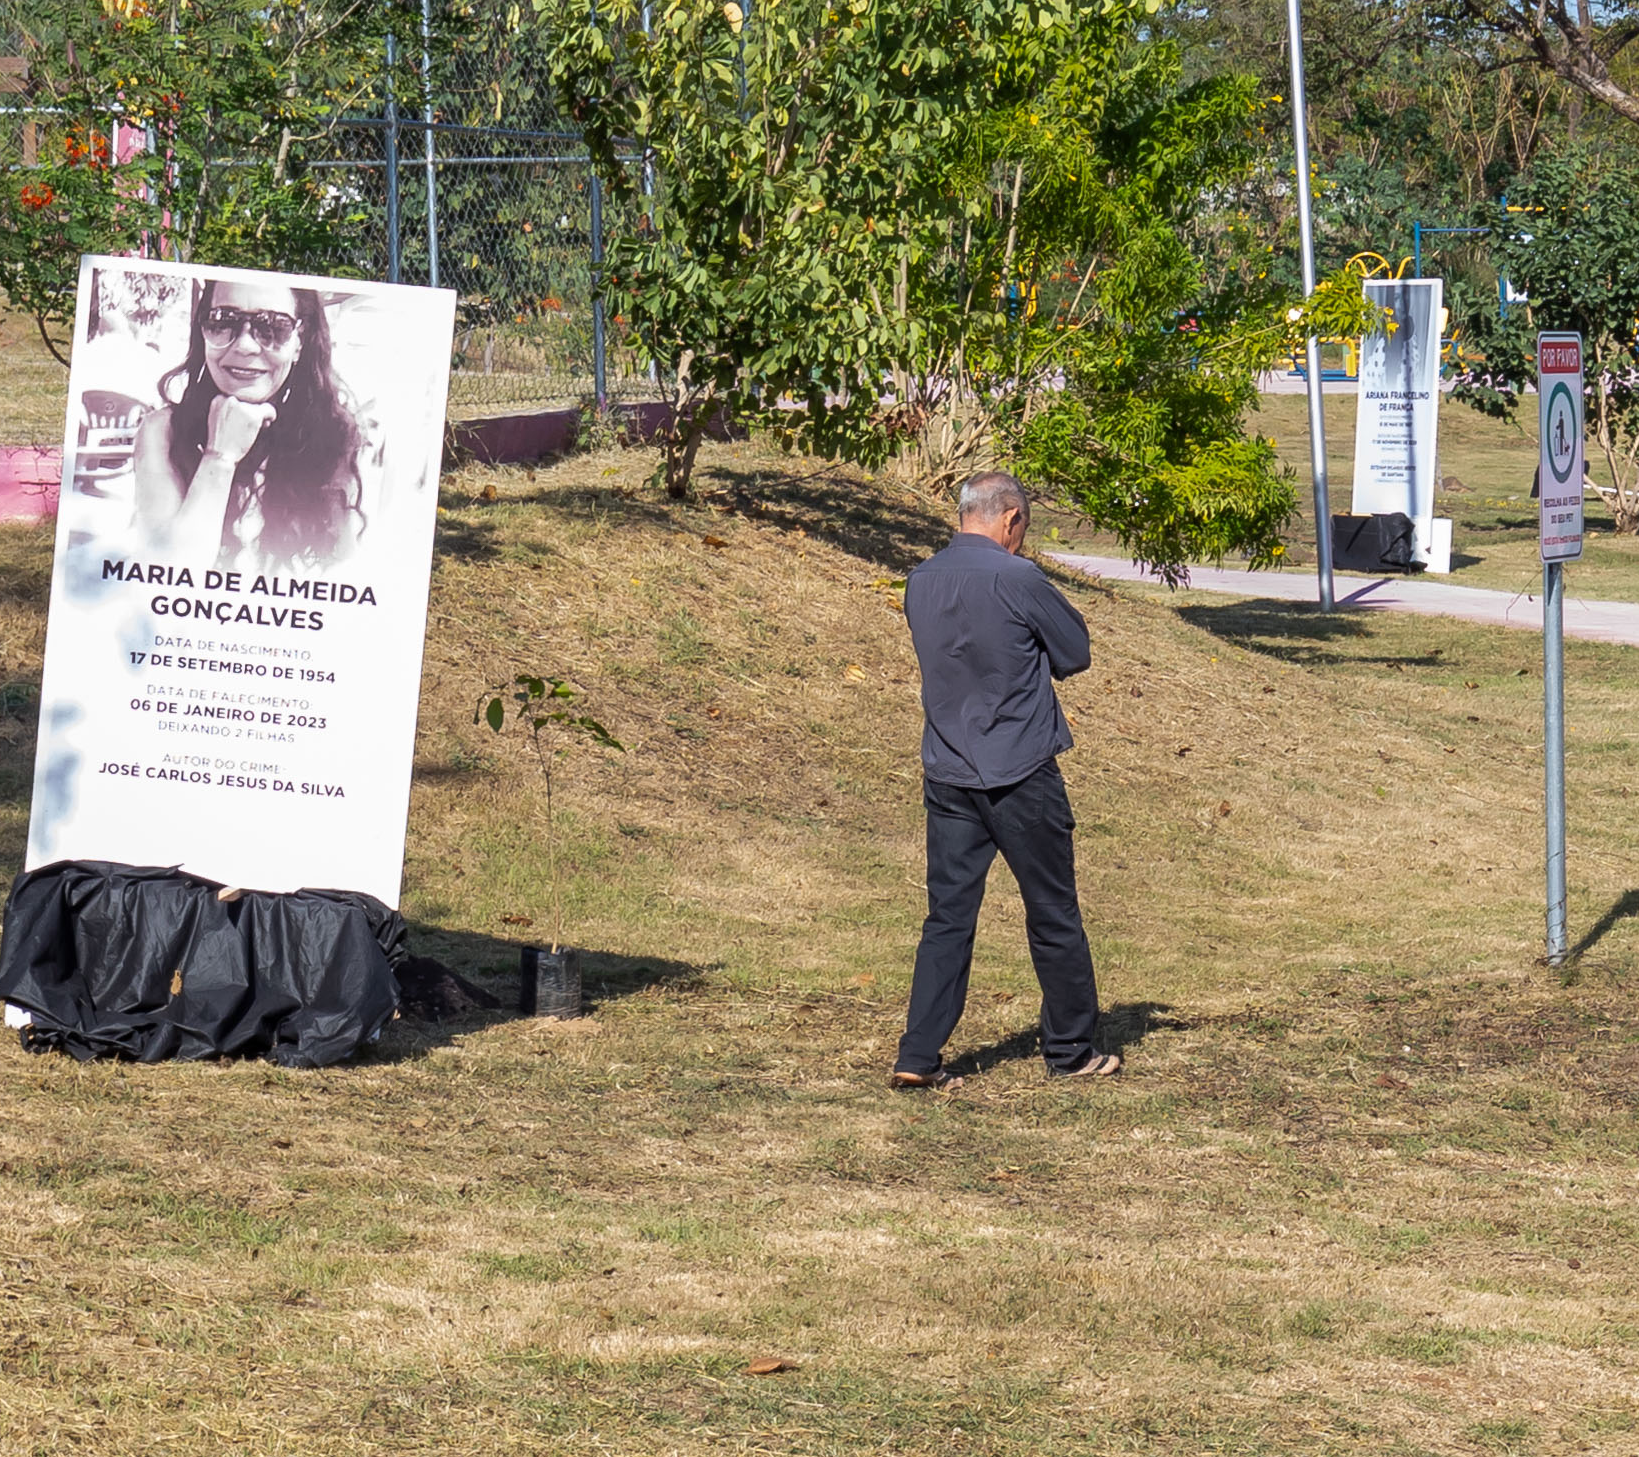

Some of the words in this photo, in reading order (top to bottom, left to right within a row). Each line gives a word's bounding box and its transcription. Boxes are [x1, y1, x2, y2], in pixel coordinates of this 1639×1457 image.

[1543, 348, 1555, 367] POR
[1557, 348, 1578, 367] FAVOR
[1365, 391, 1389, 399] ARIANA
[1379, 403, 1386, 411] DE
[102, 559, 194, 588] MARIA
[204, 570, 242, 592] DE
[250, 575, 377, 606] ALMEIDA
[151, 595, 324, 631] GONÇALVES
[155, 635, 193, 648] DATA
[198, 640, 215, 652] DE
[130, 651, 146, 665] 17
[151, 654, 172, 667] DE
[178, 657, 267, 677] SETEMBRO
[273, 666, 294, 679] DE
[299, 669, 336, 683] 1954
[147, 684, 185, 697] DATA
[189, 689, 206, 700] DE
[130, 699, 151, 712] 06
[156, 701, 177, 714] DE
[183, 704, 255, 722] JANEIRO
[260, 712, 282, 725] DE
[287, 715, 327, 729] 2023
[158, 720, 230, 738] DEIXANDO
[235, 728, 242, 738] 2
[247, 729, 295, 743] FILHAS
[162, 753, 211, 767] AUTOR
[215, 758, 235, 770] DO
[99, 761, 140, 777] JOSÉ
[146, 767, 212, 784] CARLOS
[217, 774, 267, 790] JESUS
[273, 780, 295, 792] DA
[301, 783, 345, 798] SILVA
